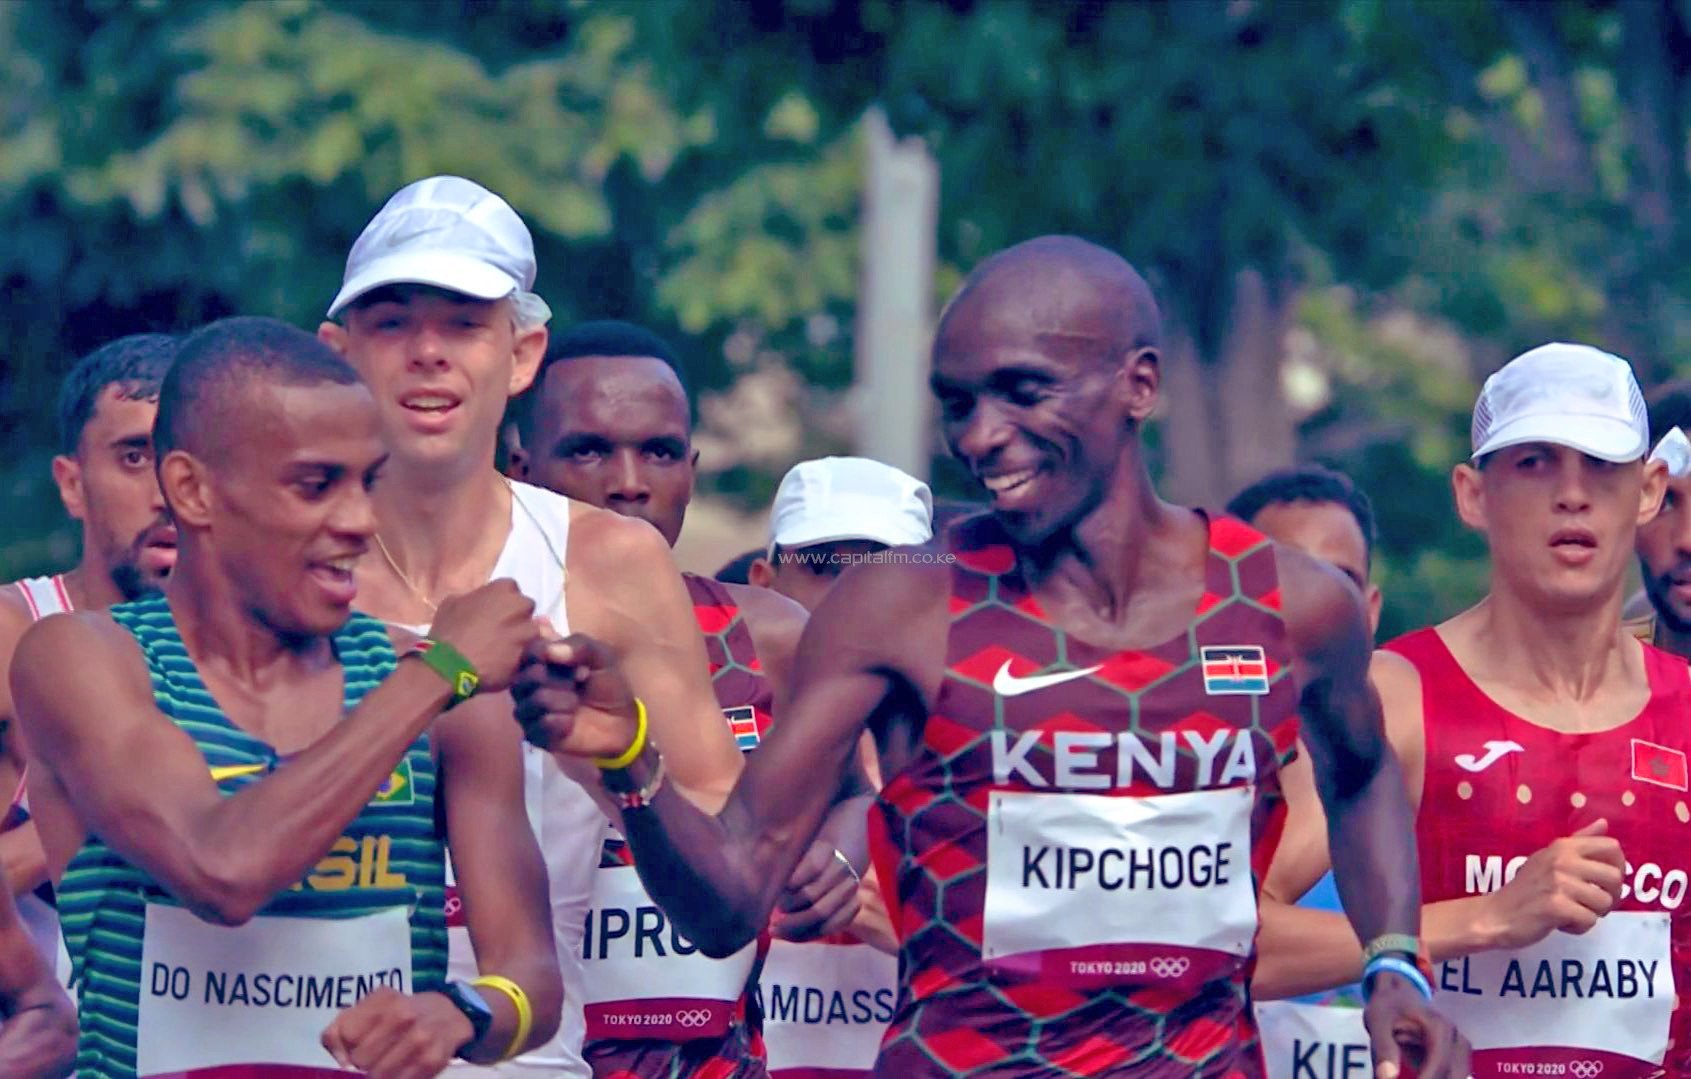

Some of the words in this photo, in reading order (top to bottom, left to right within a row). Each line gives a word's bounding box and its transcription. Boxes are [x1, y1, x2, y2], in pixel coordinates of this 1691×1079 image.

[991, 729, 1257, 788] KENYA
[292, 835, 407, 891] SIL
[1022, 842, 1232, 890] KIPCHOGE
[152, 963, 190, 1000] DO
[1070, 961, 1112, 974] TOKYO
[1115, 961, 1146, 974] 2020
[1441, 957, 1482, 995] EL
[1500, 960, 1658, 998] AARABY
[603, 1013, 642, 1025] TOKYO
[644, 1013, 672, 1025] 2020
[1497, 1062, 1535, 1074] TOKYO
[1537, 1063, 1566, 1075] 2020
